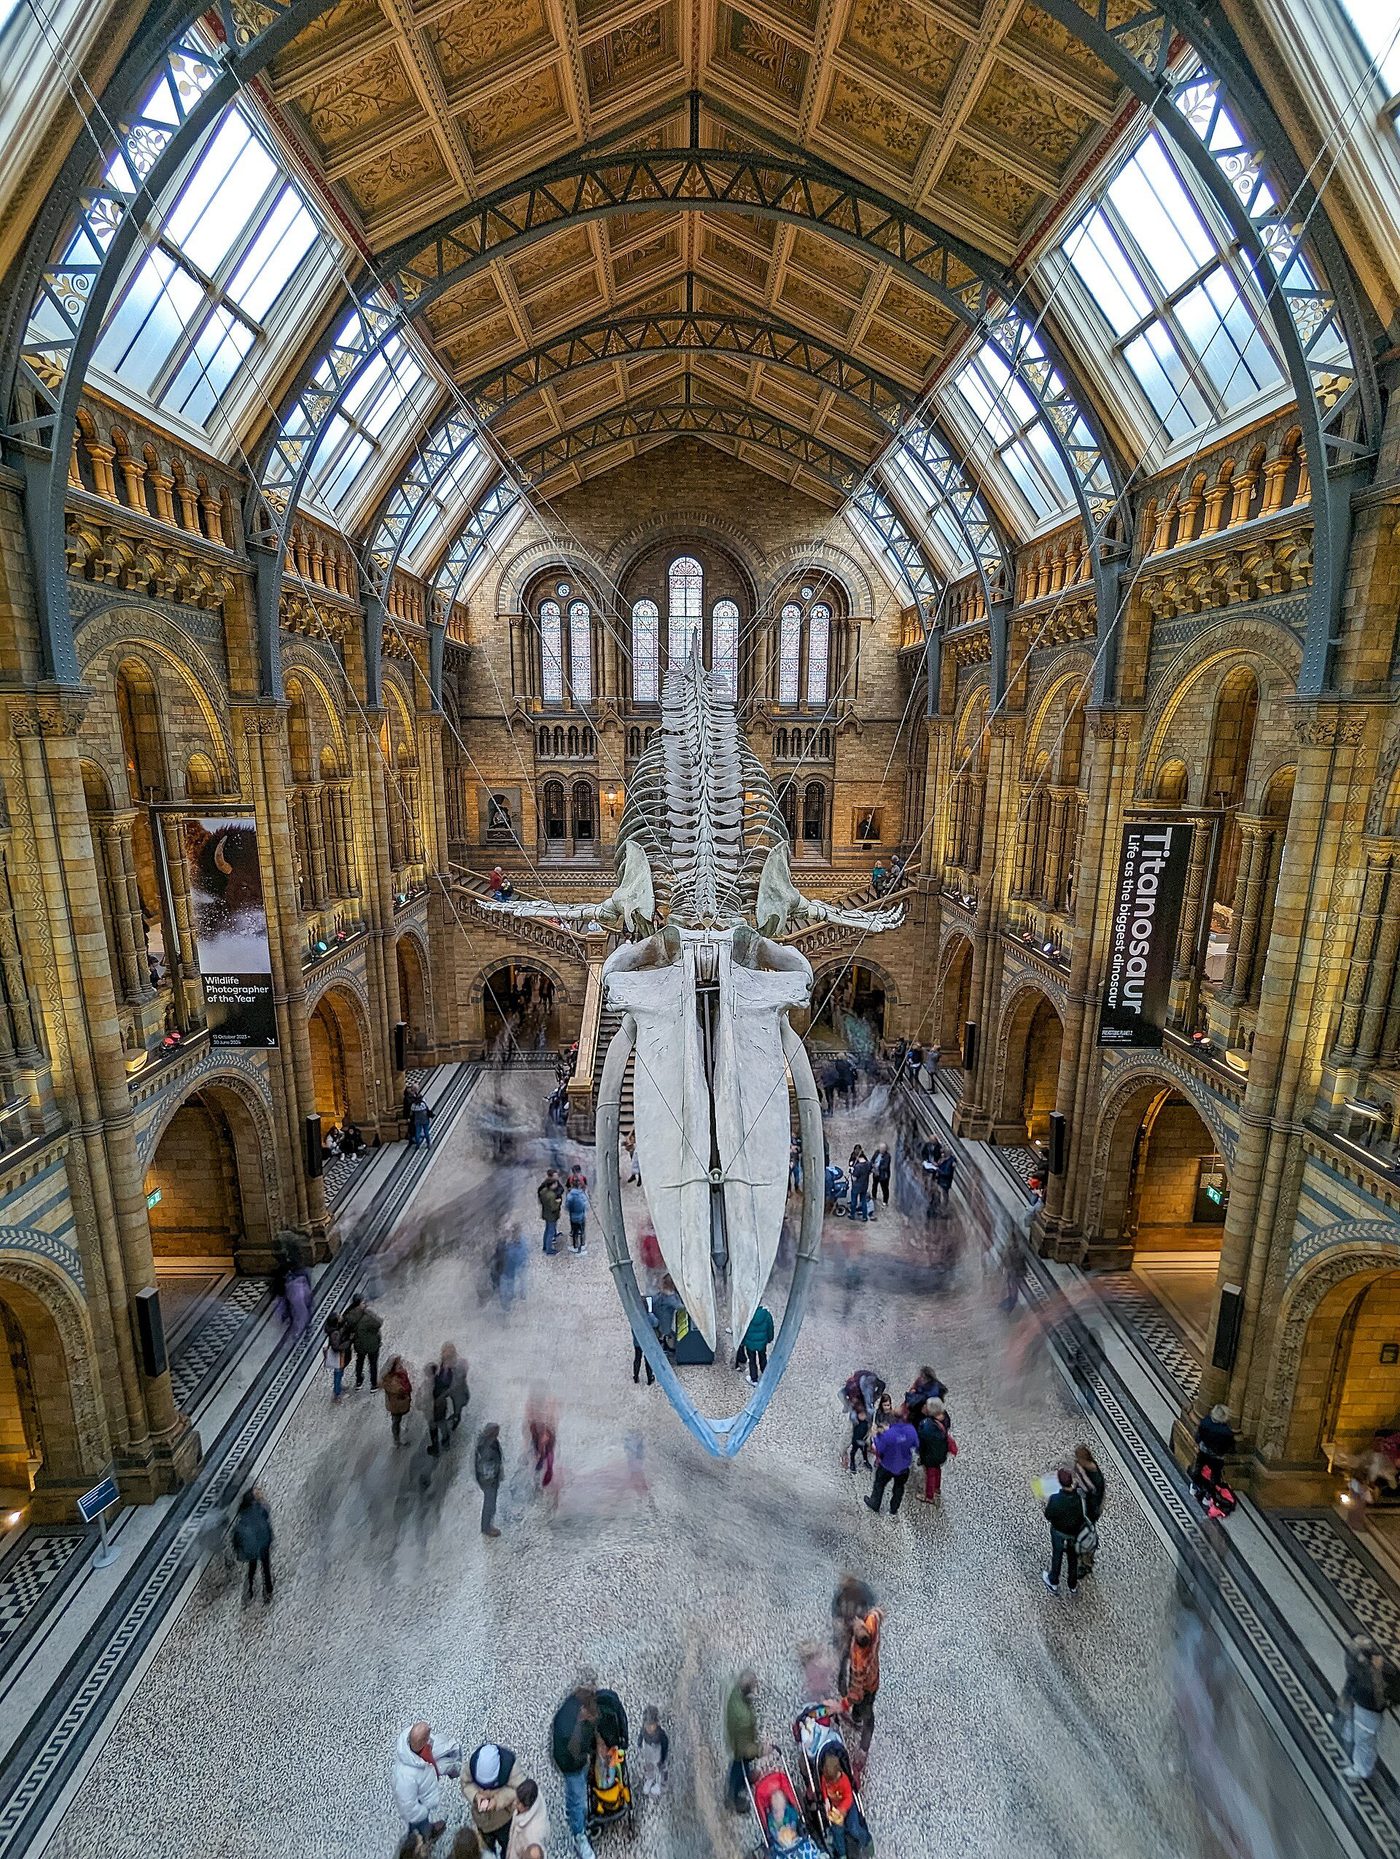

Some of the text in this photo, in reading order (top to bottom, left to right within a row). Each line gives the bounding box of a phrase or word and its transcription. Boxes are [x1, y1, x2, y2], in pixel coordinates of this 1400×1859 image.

[1108, 835, 1140, 1009] Life as the biggest dinosaur
[1122, 827, 1172, 1014] Titanosaur
[205, 976, 239, 984] Wildlife
[206, 985, 269, 994] Photographer
